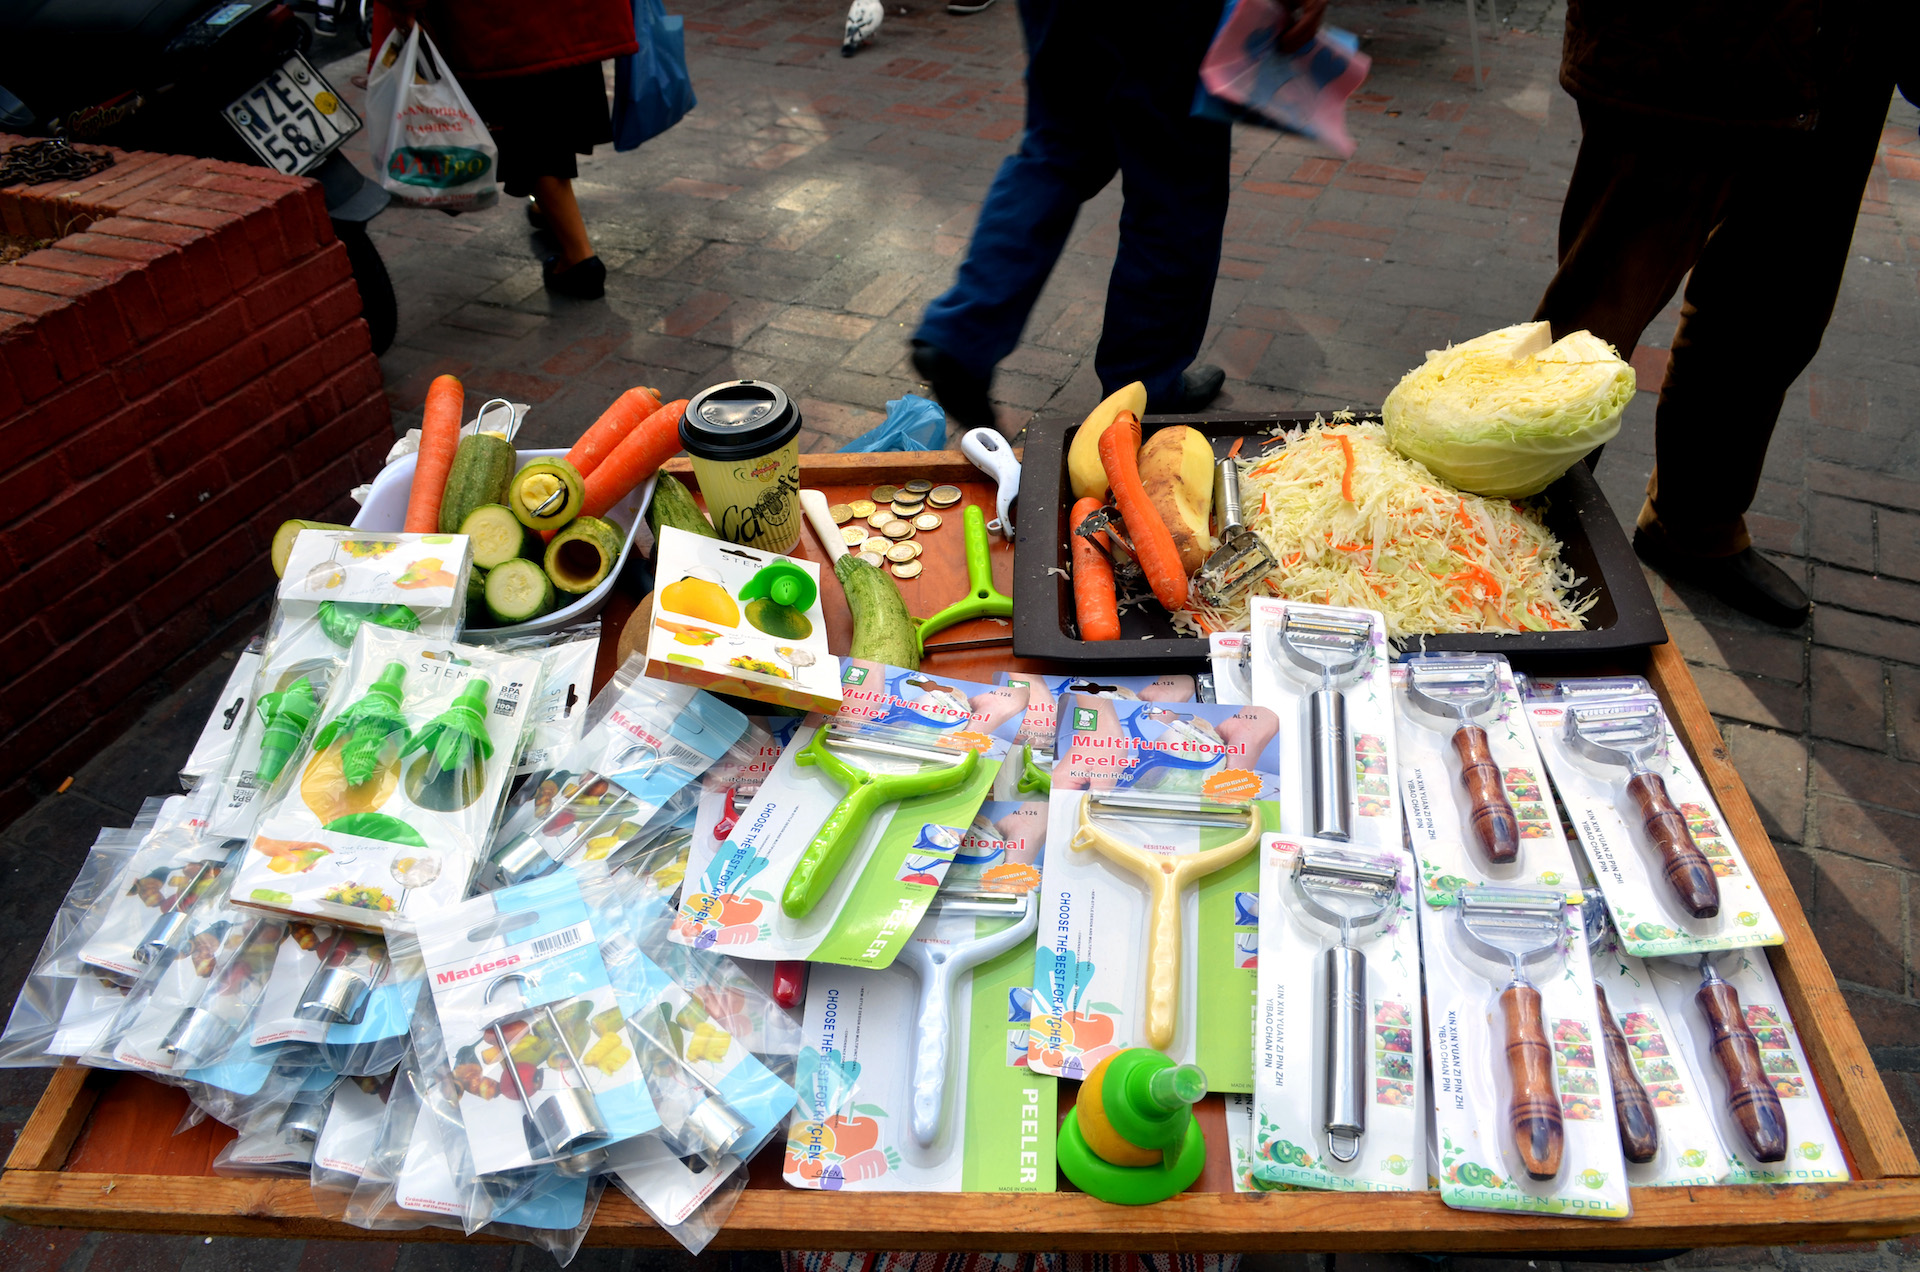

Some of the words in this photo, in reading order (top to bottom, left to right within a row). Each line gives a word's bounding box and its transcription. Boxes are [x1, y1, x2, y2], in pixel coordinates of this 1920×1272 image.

[263, 107, 325, 173] 587
[721, 554, 764, 570] STEM
[419, 662, 470, 681] STEM
[499, 692, 519, 701] FREE
[501, 686, 520, 696] BPA
[989, 690, 1012, 698] AL-126
[840, 705, 889, 720] eeler
[841, 688, 992, 723] Multifunctional
[609, 710, 663, 749] Madesa
[1072, 734, 1246, 755] Multifunctional
[1070, 753, 1140, 769] Peeler
[1070, 770, 1108, 779] Kitchen
[1110, 771, 1135, 781] Help
[1414, 767, 1422, 779] XIN
[1407, 779, 1417, 798] YIBAO
[1417, 779, 1425, 791] XIN
[1411, 798, 1421, 817] CHAN
[1419, 791, 1429, 810] YUAN
[750, 800, 777, 835] CHOOSE
[1423, 809, 1430, 817] ZI
[1425, 816, 1433, 828] PIN
[1585, 807, 1596, 821] XIN
[1414, 817, 1423, 829] PIN
[1590, 819, 1601, 833] XIN
[739, 830, 757, 851] THE
[1427, 828, 1436, 840] ZHI
[1596, 832, 1610, 853] YUAN
[1581, 819, 1595, 841] YIBAO
[1589, 840, 1603, 861] CHAN
[1598, 859, 1609, 874] PIN
[726, 846, 747, 871] BEST
[1604, 851, 1613, 861] ZI
[1607, 859, 1618, 873] PIN
[716, 867, 734, 888] FOR
[1536, 872, 1564, 885] New
[1613, 871, 1623, 885] ZHI
[692, 885, 723, 925] KITCHEN
[1057, 891, 1071, 931] CHOOSE
[866, 897, 906, 957] PEELER
[1732, 911, 1760, 927] New
[1056, 933, 1068, 952] THE
[1637, 938, 1718, 952] KITCHEN
[1726, 933, 1775, 945] TOOL
[436, 952, 521, 985] Madesa
[1054, 954, 1066, 980] BEST
[1052, 982, 1064, 1003] FOR
[822, 988, 838, 1030] CHOOSE
[1265, 998, 1273, 1024] YIBAO
[1276, 1000, 1284, 1015] XIN
[1448, 1010, 1456, 1025] XIN
[1049, 1005, 1063, 1050] KITCHEN
[1449, 1026, 1458, 1041] XIN
[820, 1032, 834, 1053] THE
[1265, 1025, 1273, 1050] CHAN
[1437, 1025, 1447, 1050] YIBAO
[1276, 1044, 1283, 1052] ZI
[1450, 1042, 1460, 1067] YUAN
[816, 1054, 831, 1082] BEST
[1057, 1059, 1081, 1068] OPEN
[1264, 1052, 1272, 1067] PIN
[1439, 1051, 1449, 1075] CHAN
[1275, 1071, 1283, 1086] ZHI
[1452, 1068, 1460, 1076] ZI
[1441, 1077, 1451, 1092] PIN
[1453, 1078, 1462, 1093] PIN
[814, 1084, 828, 1107] FOR
[1454, 1094, 1463, 1110] ZHI
[808, 1108, 825, 1160] KITCHEN
[1020, 1088, 1038, 1183] PEELER
[1676, 1150, 1708, 1168] New
[1793, 1143, 1825, 1159] New
[815, 1169, 841, 1178] OPEN
[1380, 1158, 1413, 1172] New
[1790, 1168, 1837, 1178] TOOL
[1265, 1164, 1355, 1187] KITCHEN
[1575, 1172, 1609, 1187] New
[1454, 1187, 1549, 1206] KITCHEN
[1561, 1198, 1617, 1211] TOOL
